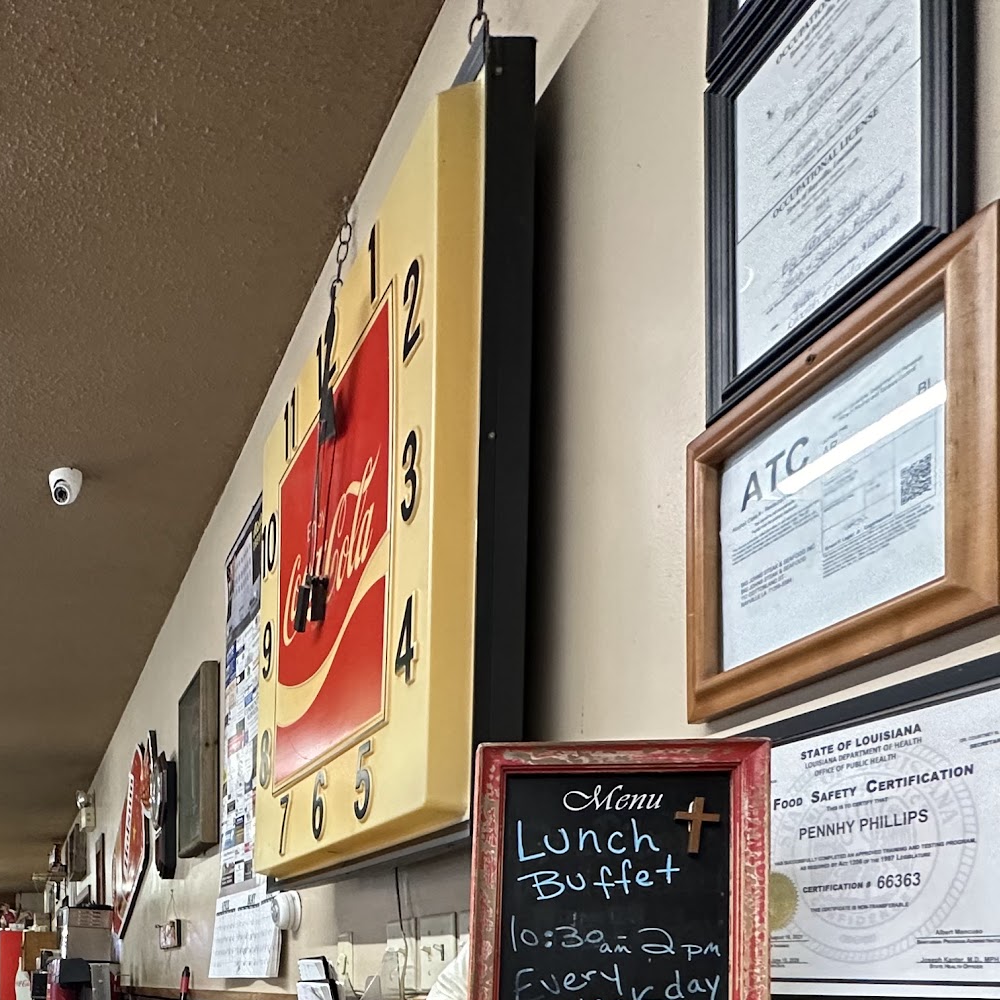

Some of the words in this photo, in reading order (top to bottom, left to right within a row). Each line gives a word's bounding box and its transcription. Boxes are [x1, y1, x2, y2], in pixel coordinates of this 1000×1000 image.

[775, 0, 827, 67] OCCUPATIO
[772, 152, 836, 219] OCCUPATIONAL
[839, 105, 878, 151] LICENSE
[368, 223, 377, 302] 1
[402, 258, 421, 364] 2
[284, 386, 298, 463] 11
[400, 429, 418, 523] 3
[741, 437, 809, 512] ATC
[262, 512, 277, 580] 10
[261, 621, 273, 680] 9
[394, 593, 415, 685] 4
[258, 729, 272, 790] 8
[800, 744, 833, 760] STATE
[837, 739, 851, 751] OF
[855, 722, 921, 747] LOUISIANA
[805, 755, 836, 769] LOUISIANA
[838, 745, 881, 761] DEPARTMENT
[883, 742, 892, 751] OF
[894, 735, 922, 748] HEALTH
[814, 766, 834, 777] OFFICE
[835, 764, 843, 772] OF
[846, 758, 868, 770] PUBLIC
[870, 752, 896, 764] HEALTH
[311, 772, 327, 841] 6
[353, 739, 372, 821] 5
[563, 785, 664, 812] Menu
[279, 795, 290, 856] 7
[517, 818, 660, 862] Lunch
[799, 819, 854, 840] PENNHY
[859, 807, 928, 831] PHILLIPS
[517, 854, 681, 901] Buffet
[802, 880, 862, 894] CERTIFICATION
[877, 871, 920, 889] 66363
